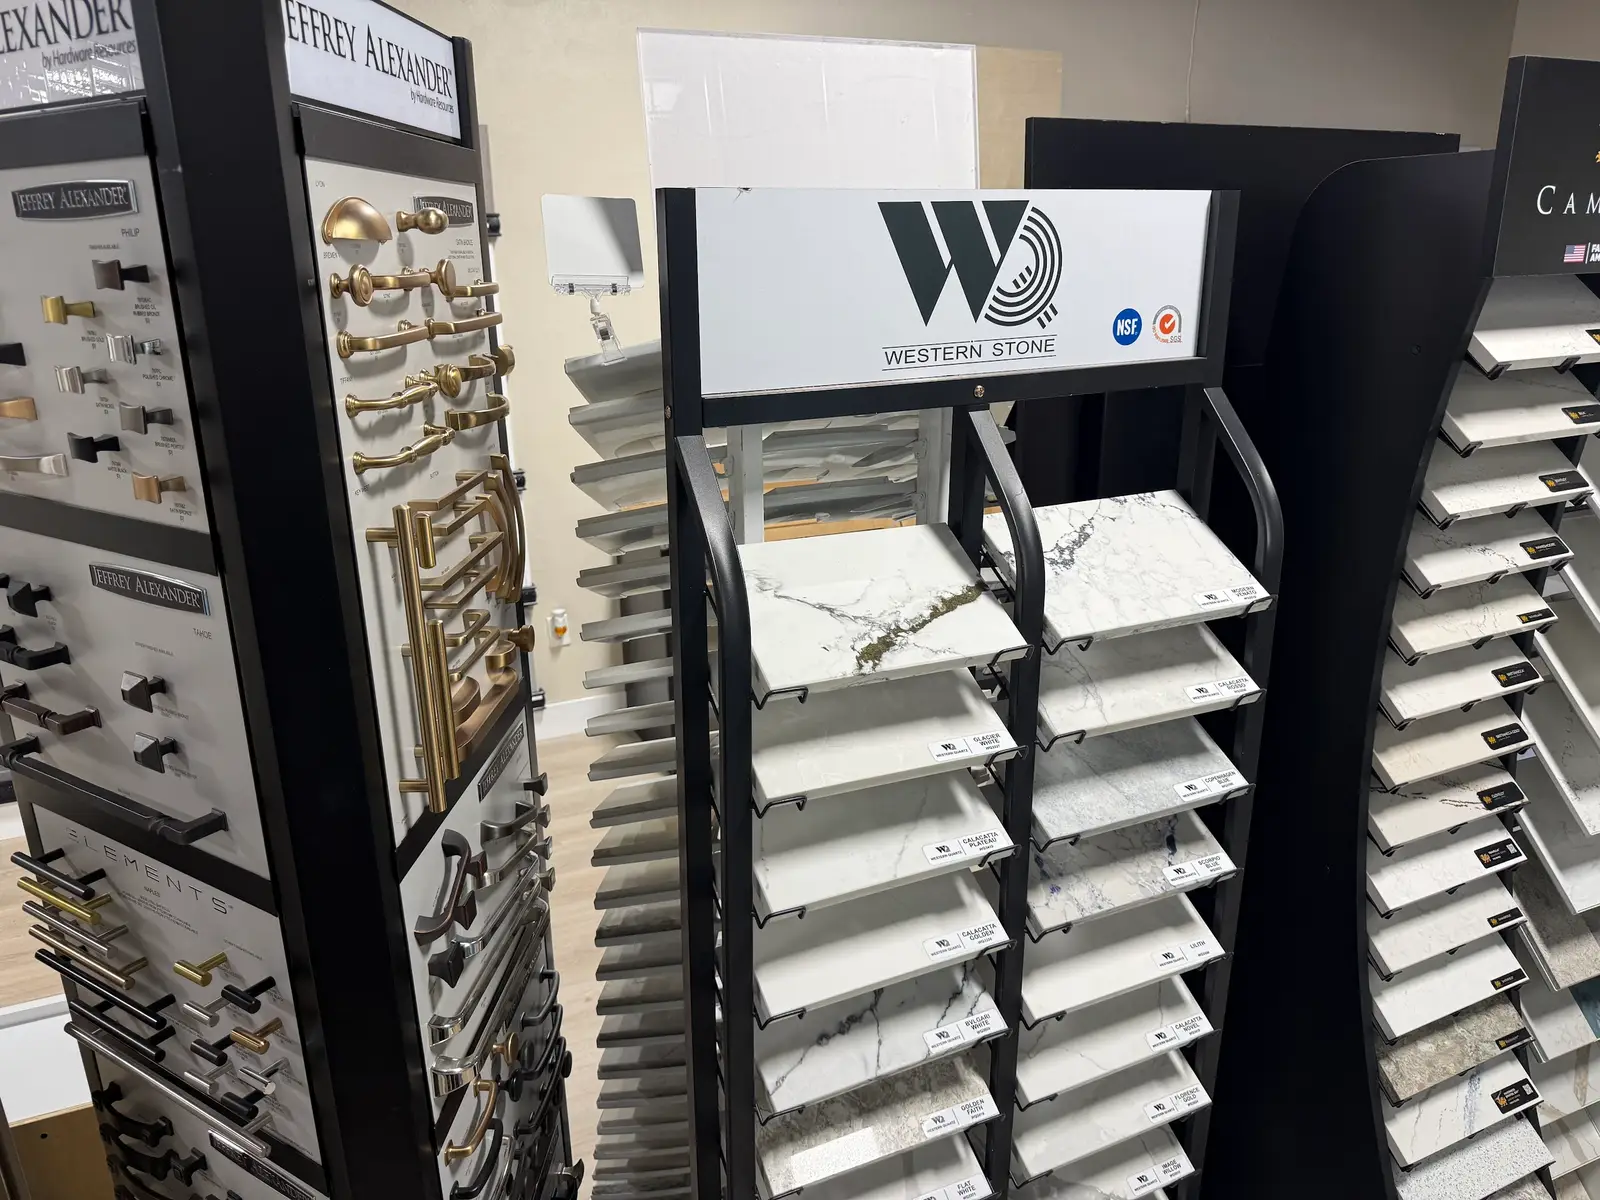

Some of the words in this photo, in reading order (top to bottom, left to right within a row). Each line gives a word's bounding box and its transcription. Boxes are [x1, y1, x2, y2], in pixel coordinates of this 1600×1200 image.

[42, 51, 52, 70] by
[52, 47, 92, 66] Hardware
[94, 40, 136, 58] Resources
[16, 191, 55, 211] JEFFREY
[60, 187, 128, 209] ALEXANDER
[121, 228, 140, 237] PHILIP
[1117, 318, 1138, 336] NSF
[884, 344, 983, 366] WESTERN
[992, 338, 1056, 358] STONE
[93, 565, 132, 591] JEFFREY
[135, 576, 200, 608] ALEXANDER
[192, 627, 213, 640] TAHOE
[1218, 678, 1249, 688] CALACATTA
[973, 733, 1001, 742] GLACIER
[979, 738, 1000, 747] WHITE
[1204, 771, 1236, 783] COPENHAGEN
[962, 831, 999, 844] CALACATTA
[968, 837, 997, 848] PLATEAU
[1198, 856, 1221, 866] SCORPIO
[1205, 861, 1220, 869] BLUE
[961, 923, 997, 938] CALACATTA
[969, 930, 995, 941] GOLDEN
[1189, 940, 1206, 949] LILITH
[964, 1013, 991, 1027] BVLGARI
[971, 1020, 990, 1030] WHITE
[1174, 1015, 1203, 1030] CALACATTA
[1183, 1023, 1201, 1032] NOVEL
[1174, 1086, 1200, 1101] FLORENCE
[1183, 1094, 1197, 1103] GOLD
[960, 1098, 985, 1111] GOLDEN
[966, 1105, 984, 1115] FAITH
[1161, 1158, 1178, 1169] IMAGE
[1162, 1163, 1182, 1175] WILLOW
[957, 1180, 971, 1190] FLAT
[957, 1184, 976, 1196] WHITE
